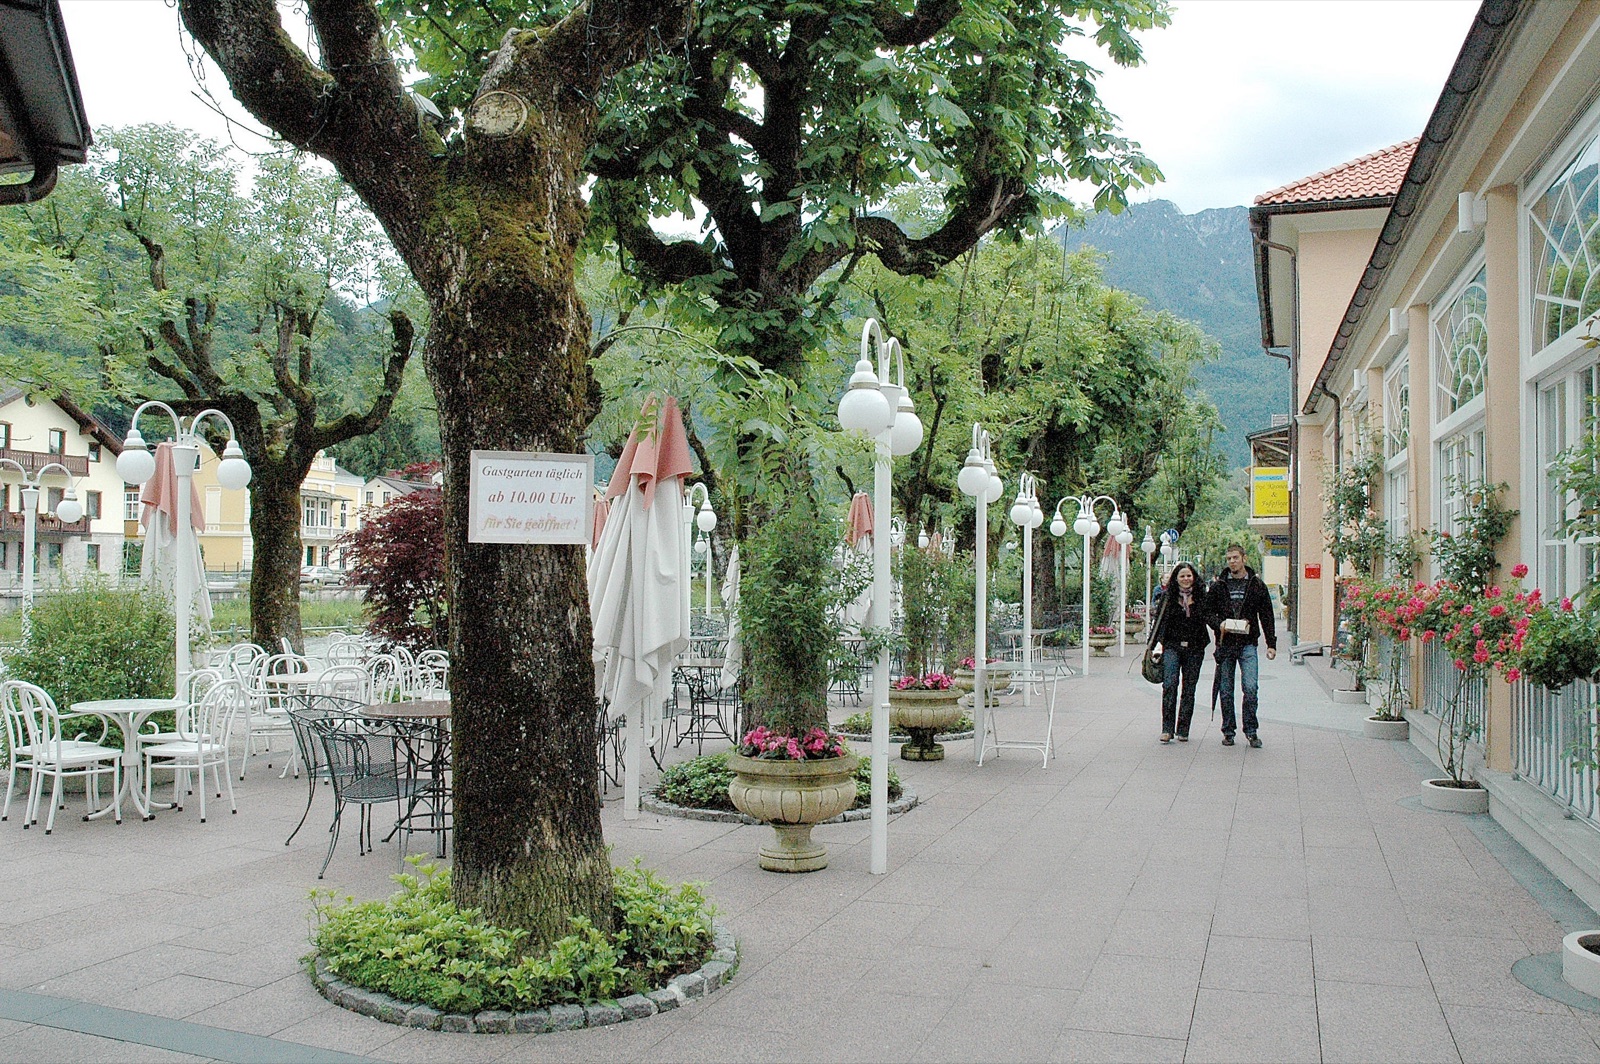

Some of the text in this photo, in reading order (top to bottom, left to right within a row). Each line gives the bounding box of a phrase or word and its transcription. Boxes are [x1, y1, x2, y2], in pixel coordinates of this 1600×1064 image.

[482, 465, 583, 481] Gastgarten täglich
[488, 490, 576, 505] ab 10.00 Uhr
[483, 517, 502, 531] für
[504, 517, 522, 529] Sie
